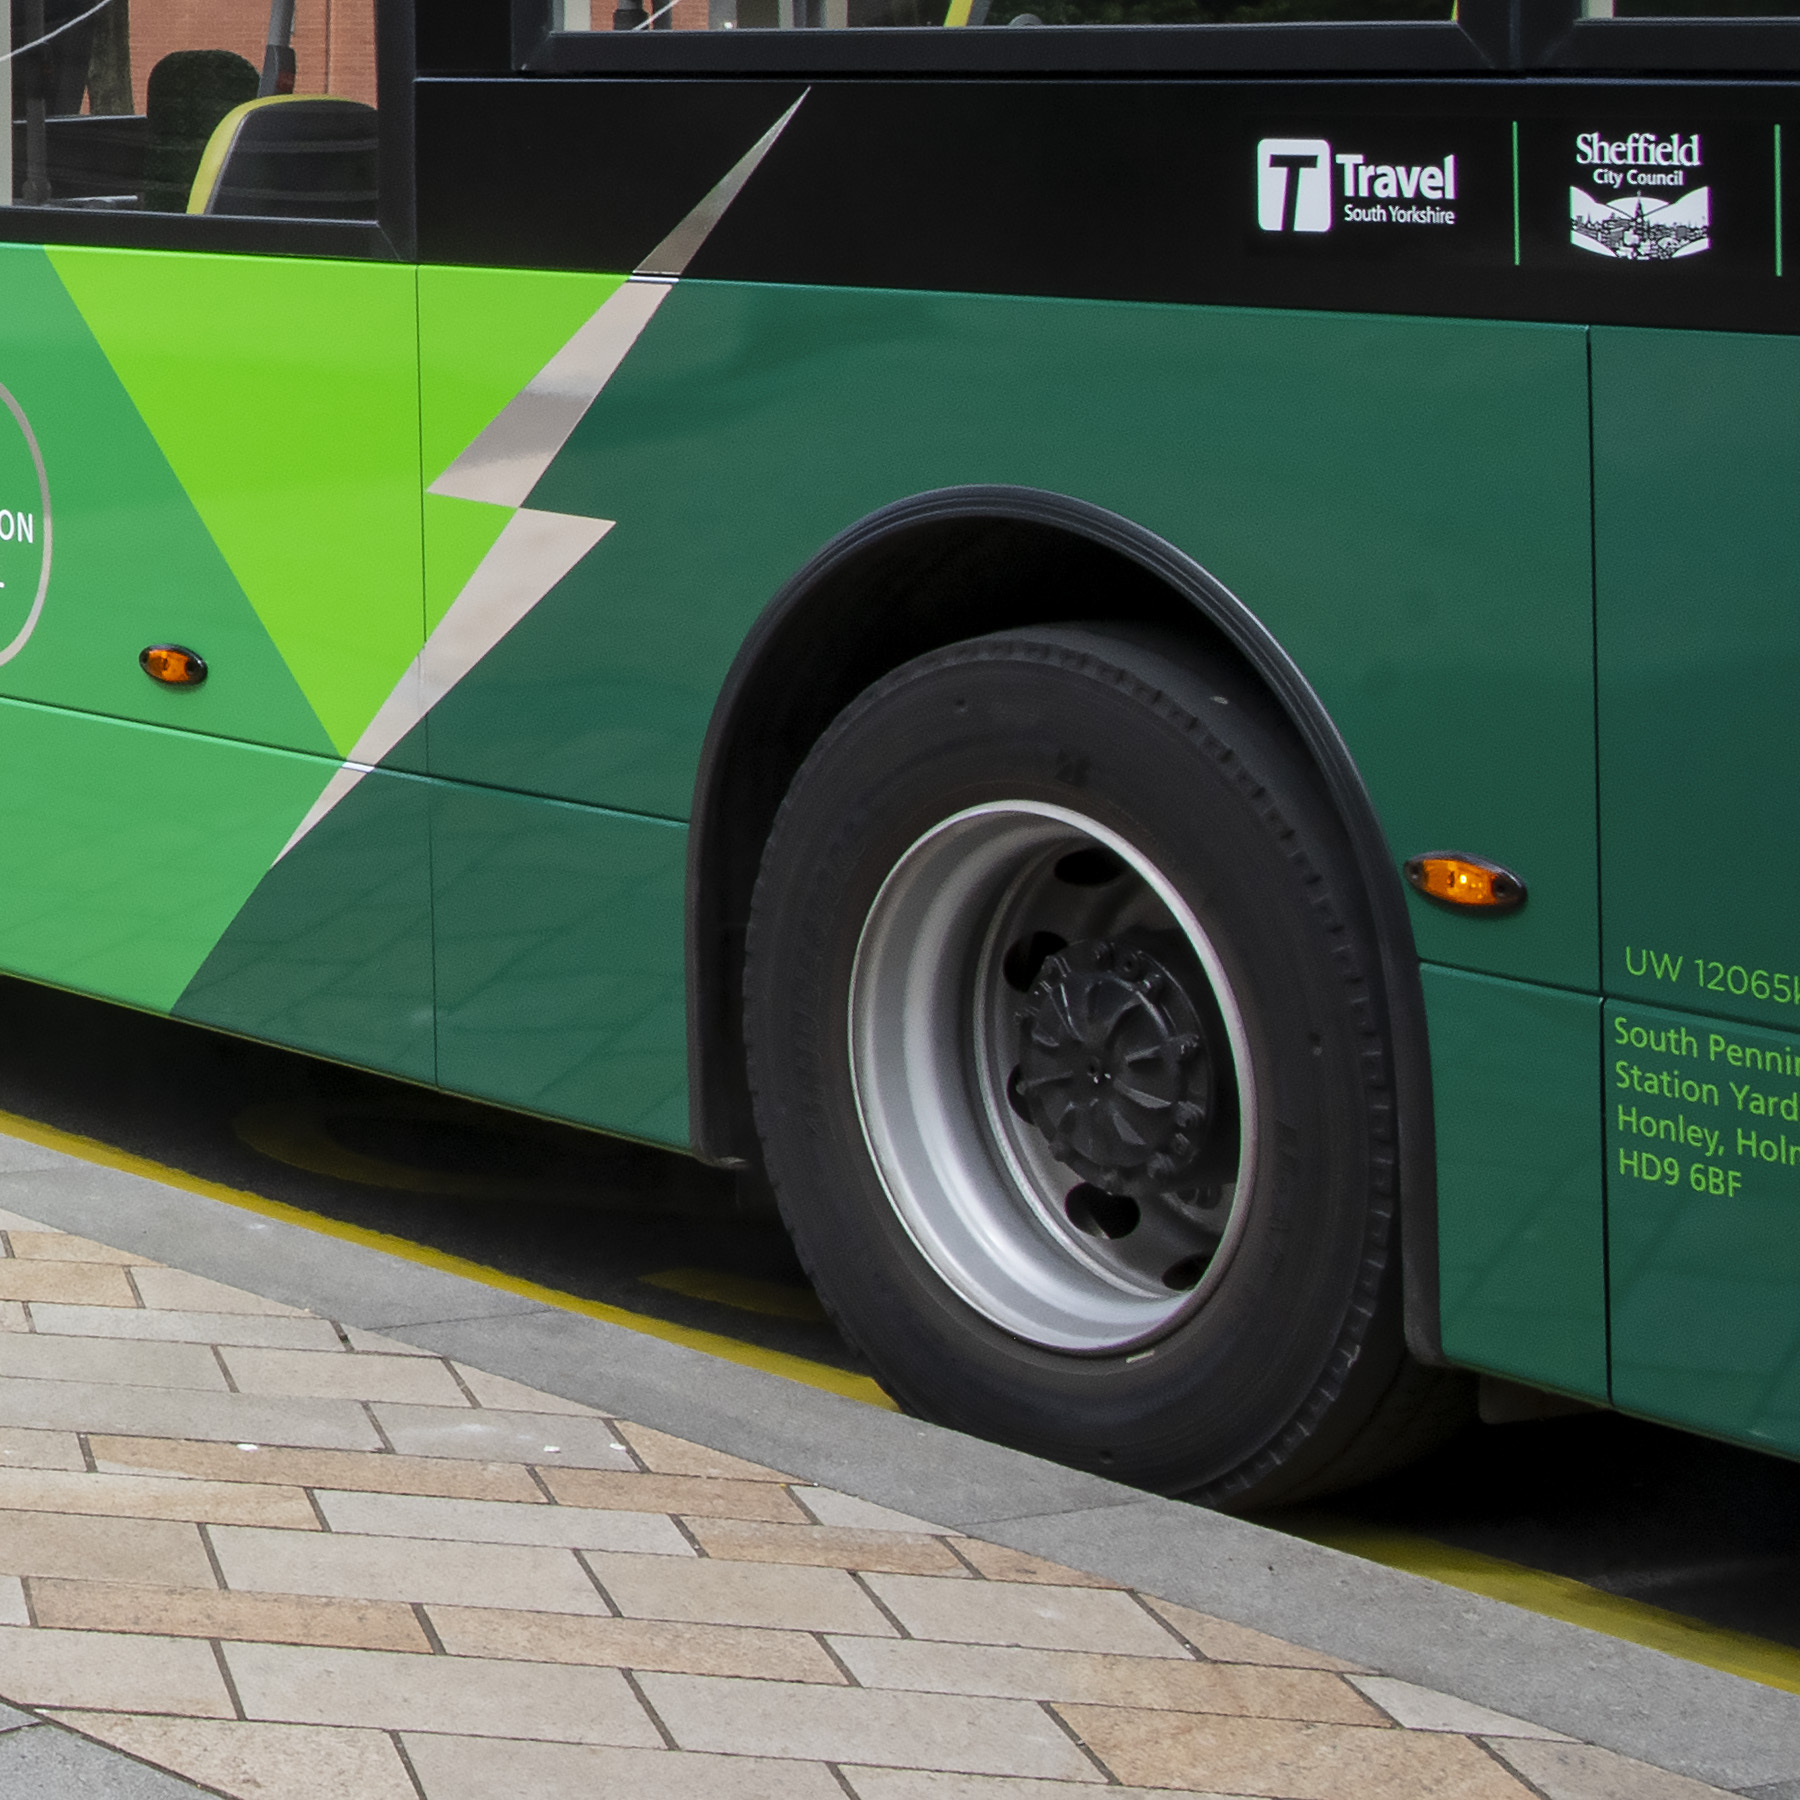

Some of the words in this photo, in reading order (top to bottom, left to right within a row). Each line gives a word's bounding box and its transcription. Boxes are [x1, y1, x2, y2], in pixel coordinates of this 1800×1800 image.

[1576, 131, 1703, 167] Sheffield
[1336, 153, 1456, 200] Travel
[1593, 168, 1628, 187] City
[1631, 168, 1684, 187] Council
[1344, 204, 1387, 223] South
[1390, 205, 1456, 226] Yorkshire
[1625, 945, 1684, 983] UW
[1614, 1016, 1699, 1059] South
[1615, 1060, 1720, 1107] Station
[1617, 1103, 1725, 1157] Honley,
[1619, 1147, 1681, 1186] HD9
[1689, 1162, 1742, 1198] 6BF
